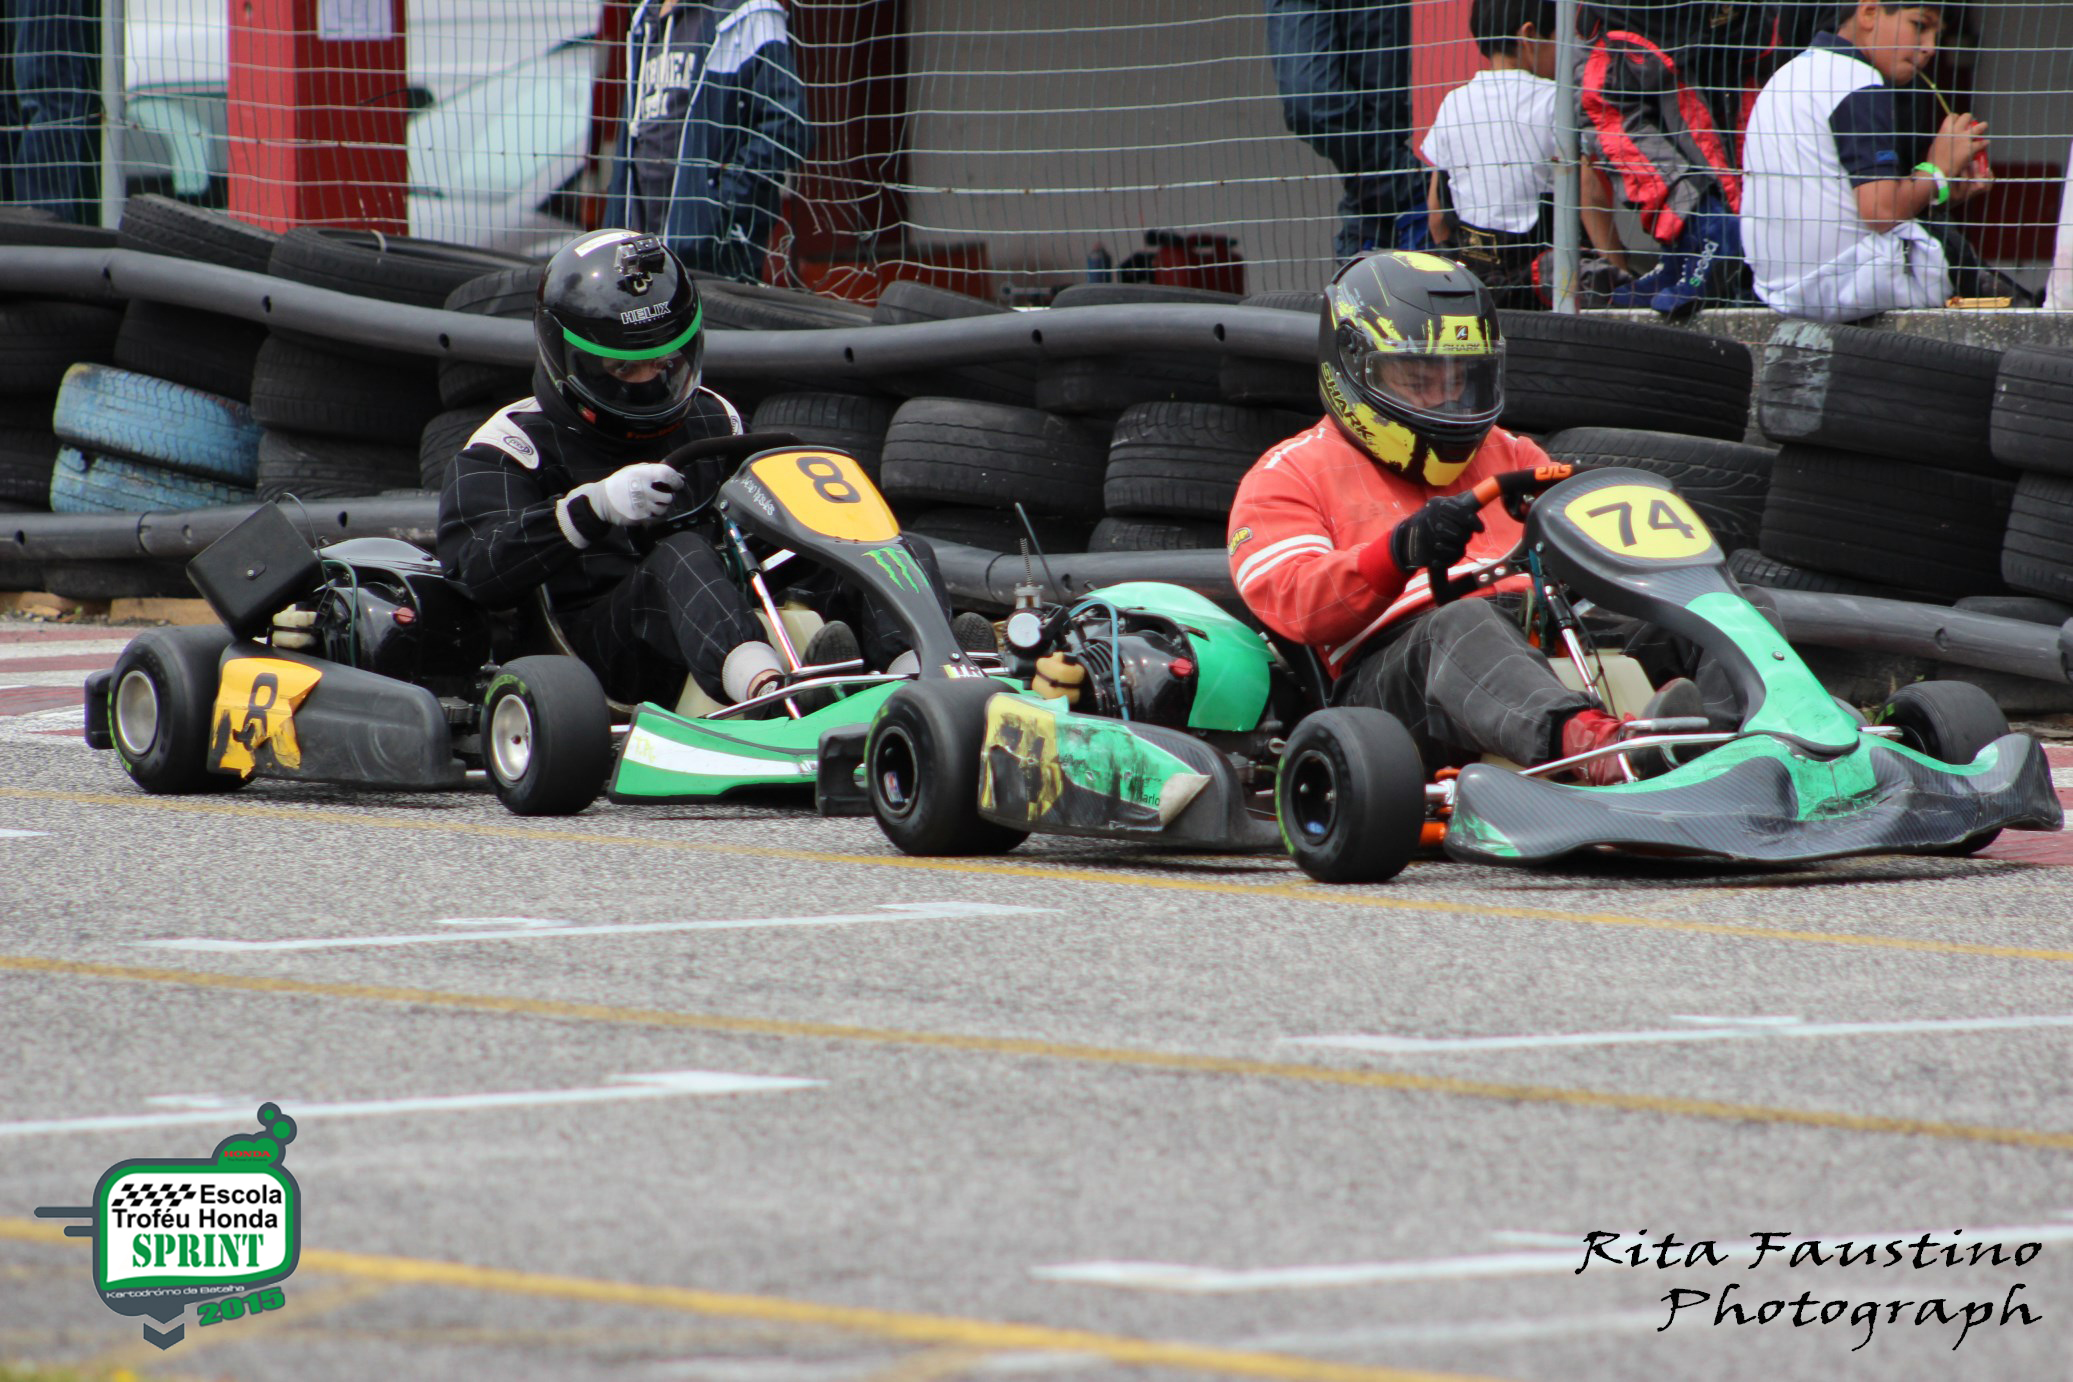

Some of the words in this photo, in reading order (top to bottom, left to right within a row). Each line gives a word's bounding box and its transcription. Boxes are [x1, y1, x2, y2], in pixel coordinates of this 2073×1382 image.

[620, 301, 672, 325] HELIX
[1321, 362, 1377, 440] SHARK
[796, 456, 862, 504] 8
[1585, 499, 1697, 548] 74
